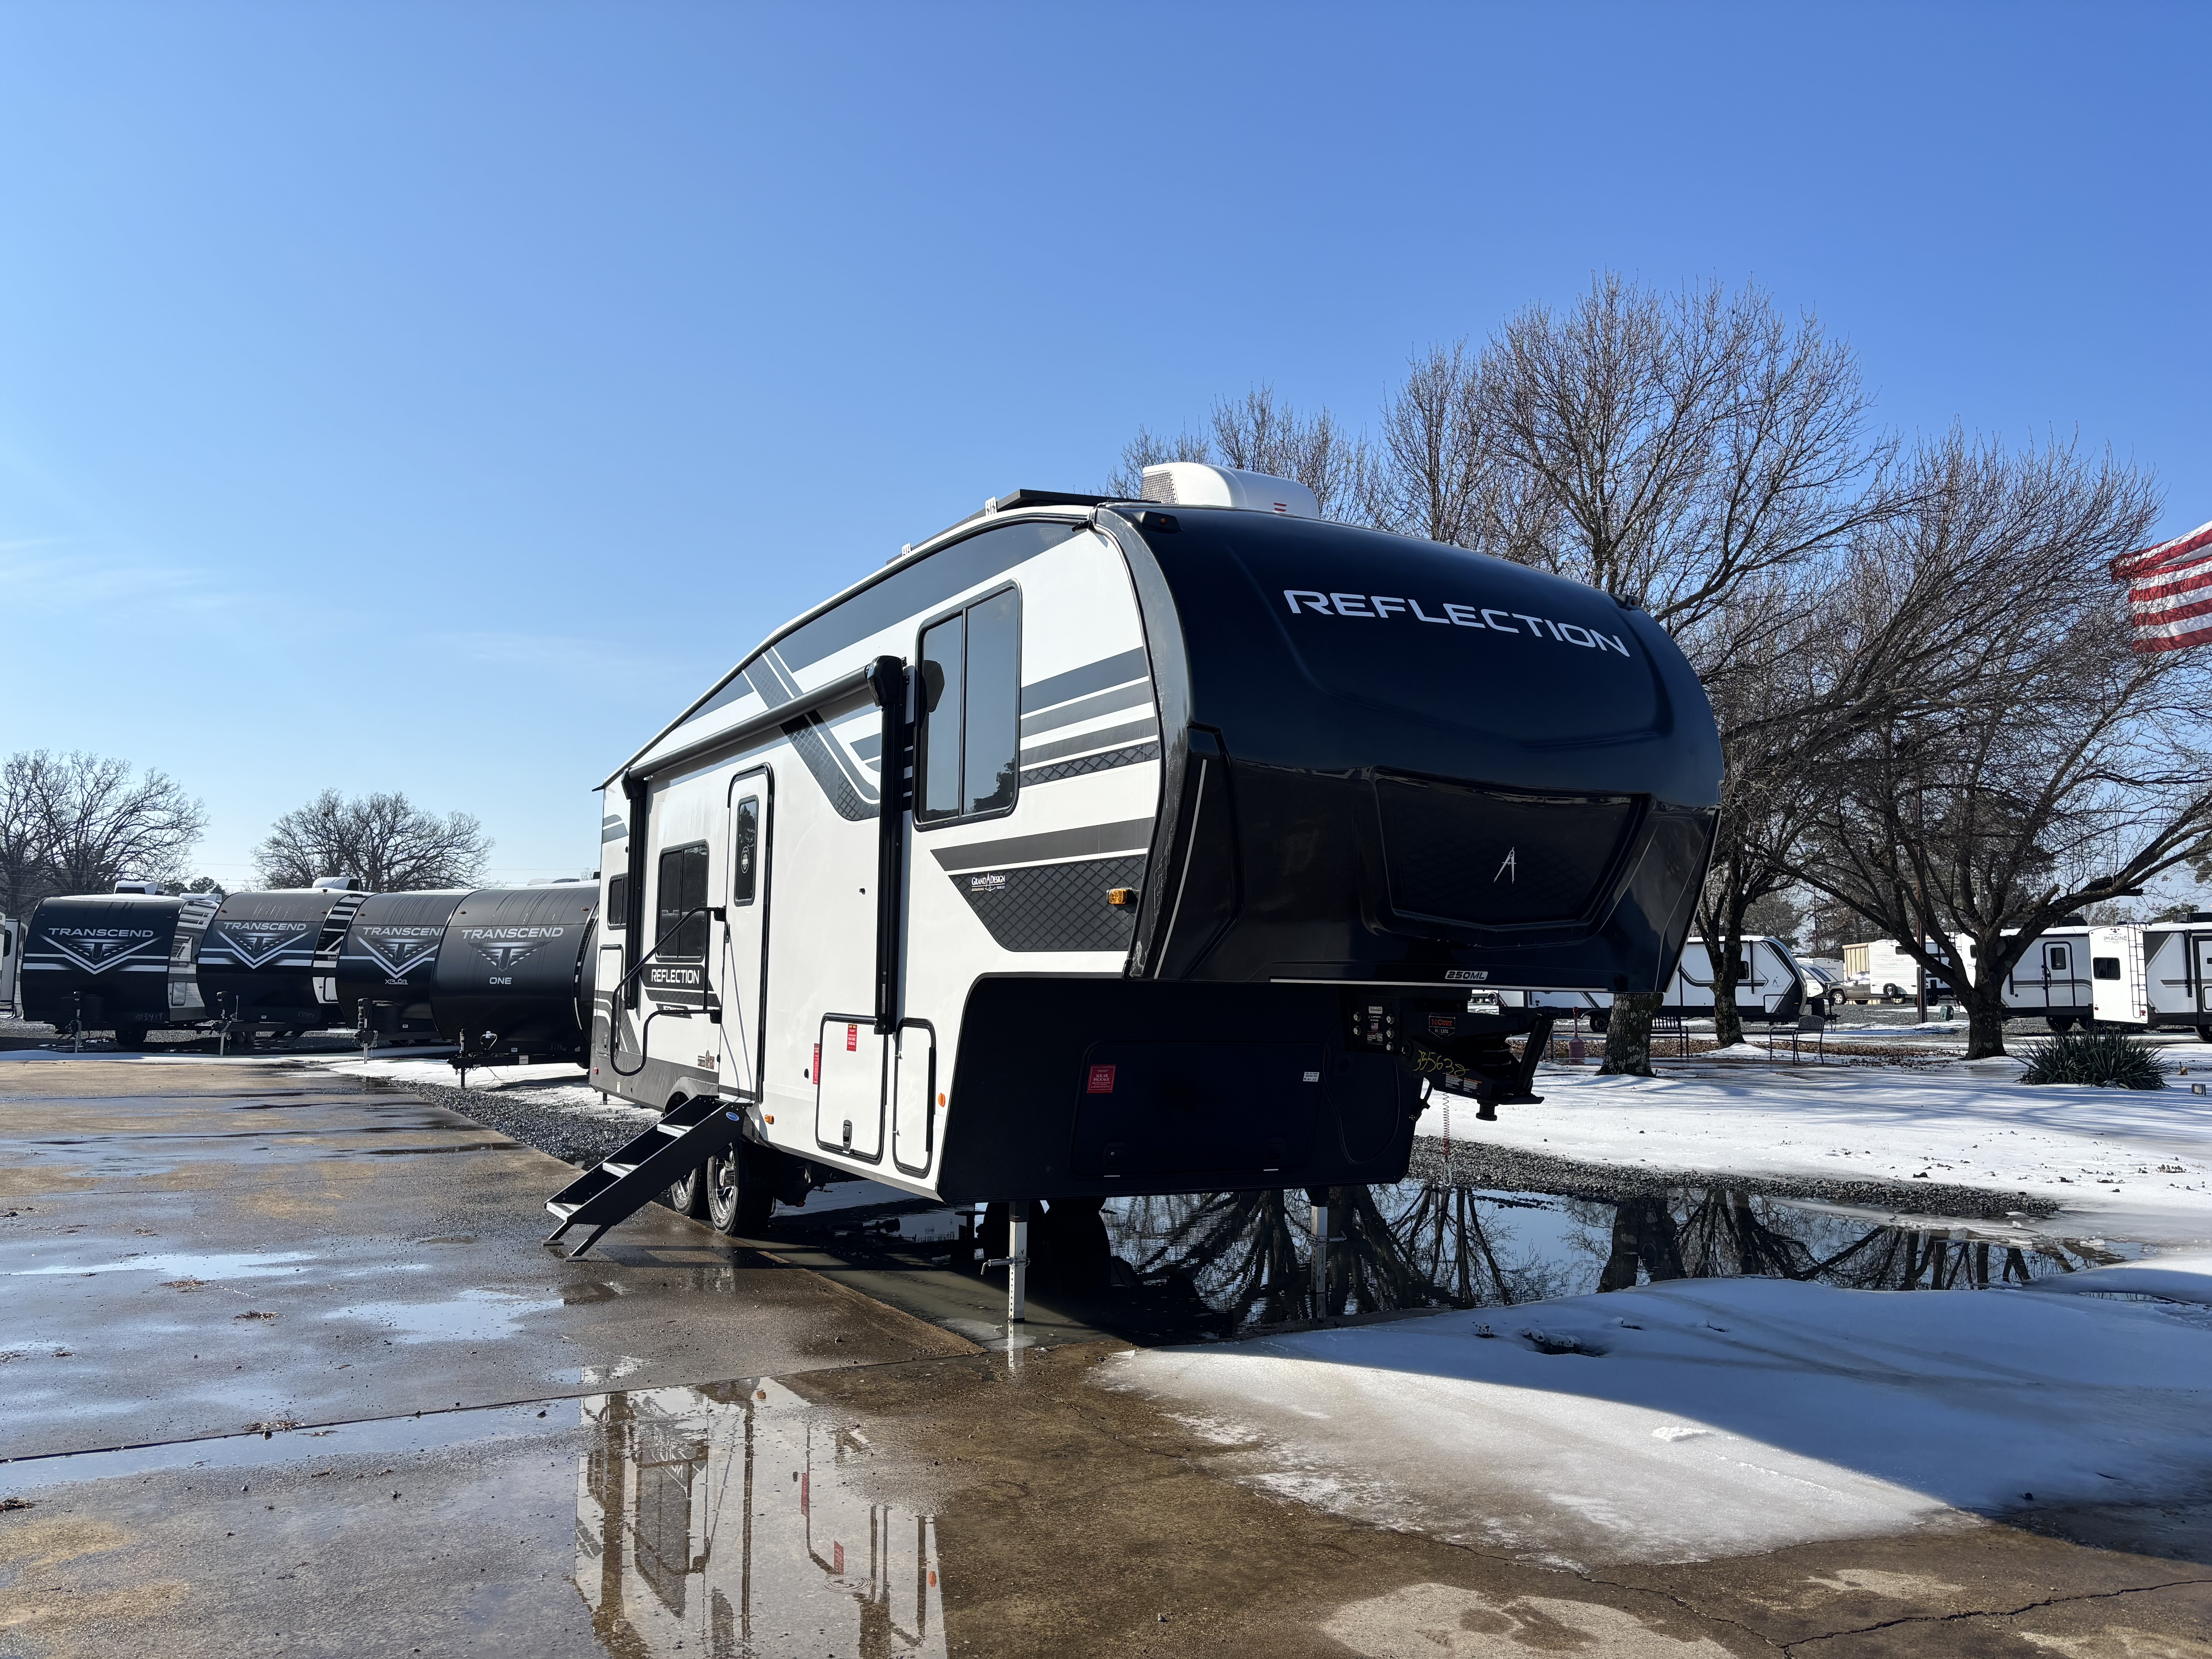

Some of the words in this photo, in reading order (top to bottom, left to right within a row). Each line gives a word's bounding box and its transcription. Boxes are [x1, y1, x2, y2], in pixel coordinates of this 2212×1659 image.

[1283, 590, 1630, 657] REFLECTION
[972, 877, 986, 885] GRAND
[990, 875, 1005, 883] DESIGN
[223, 922, 306, 931] TRANSCEND
[48, 928, 154, 937] TRANSCEND
[462, 927, 563, 939] TRANSCEND
[651, 969, 699, 984] REFLECTION
[1447, 971, 1485, 979] 250ML
